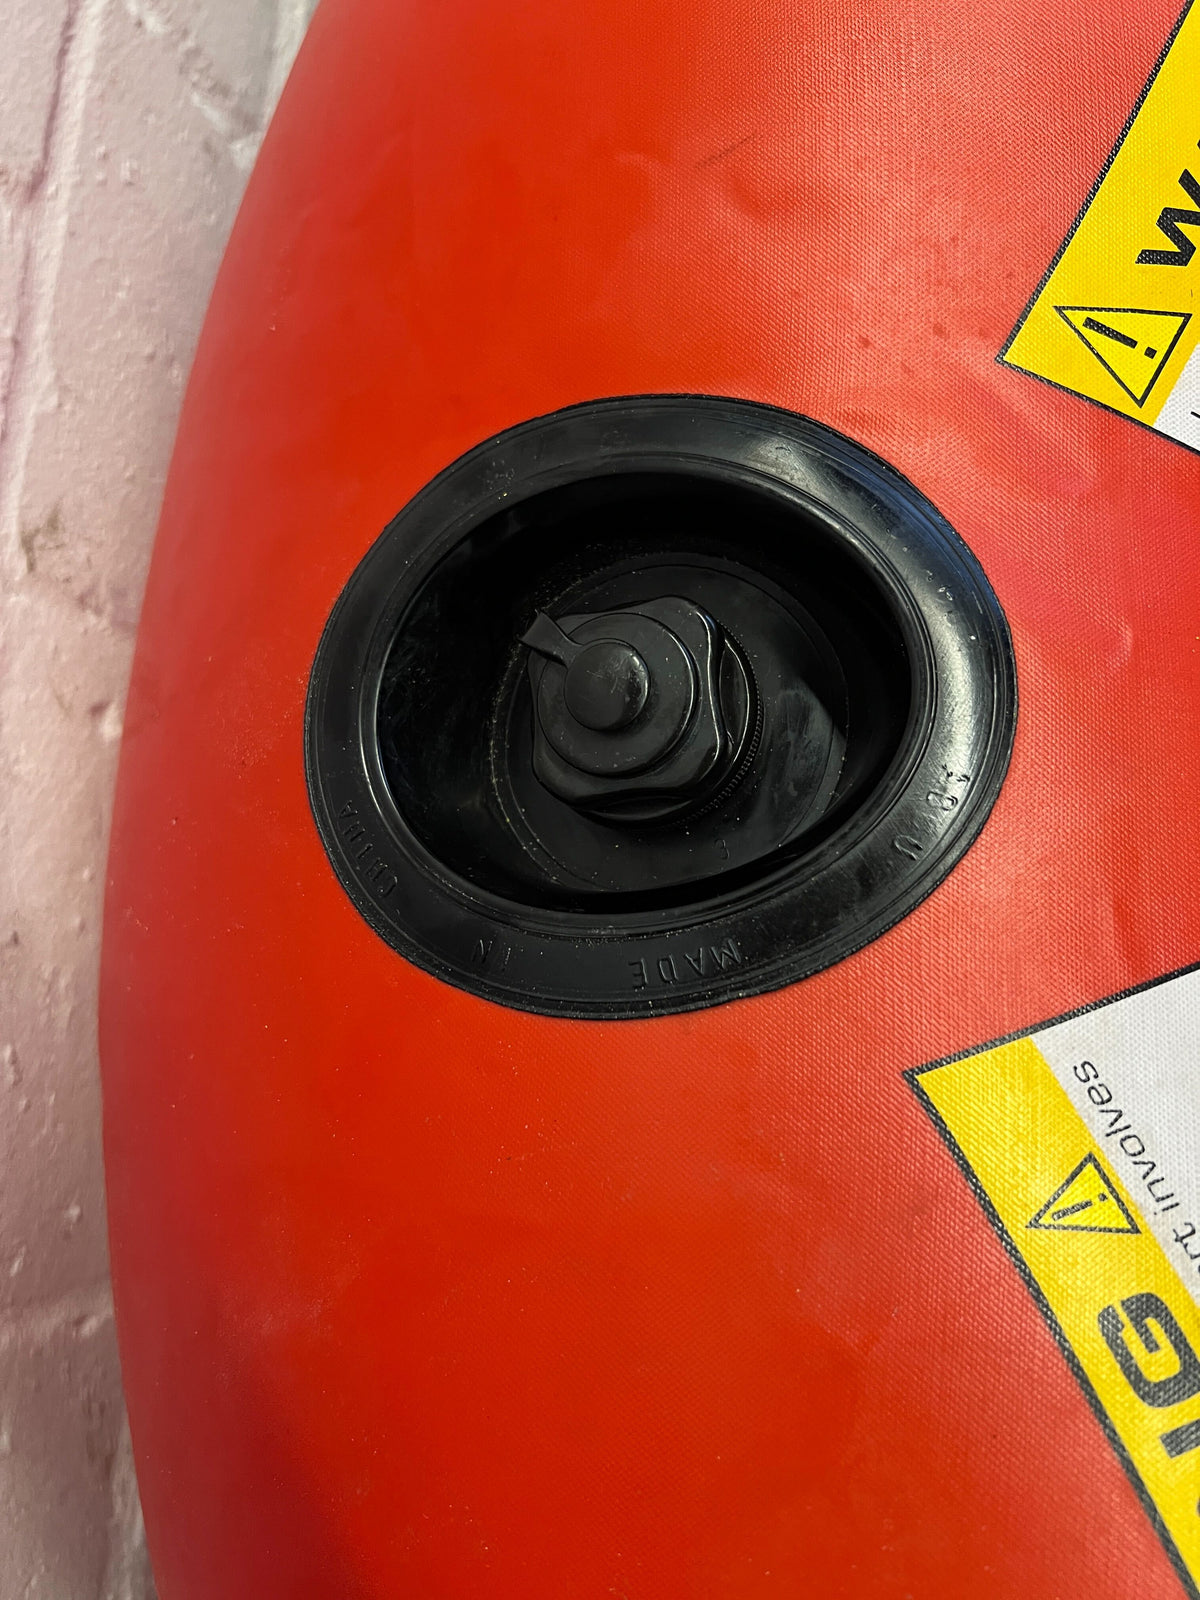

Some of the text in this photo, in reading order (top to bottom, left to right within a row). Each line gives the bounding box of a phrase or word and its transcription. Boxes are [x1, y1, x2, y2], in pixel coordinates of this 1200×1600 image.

[1135, 141, 1200, 267] W
[338, 801, 399, 898] CHINA
[627, 938, 742, 991] MADE
[1073, 1060, 1180, 1216] involves
